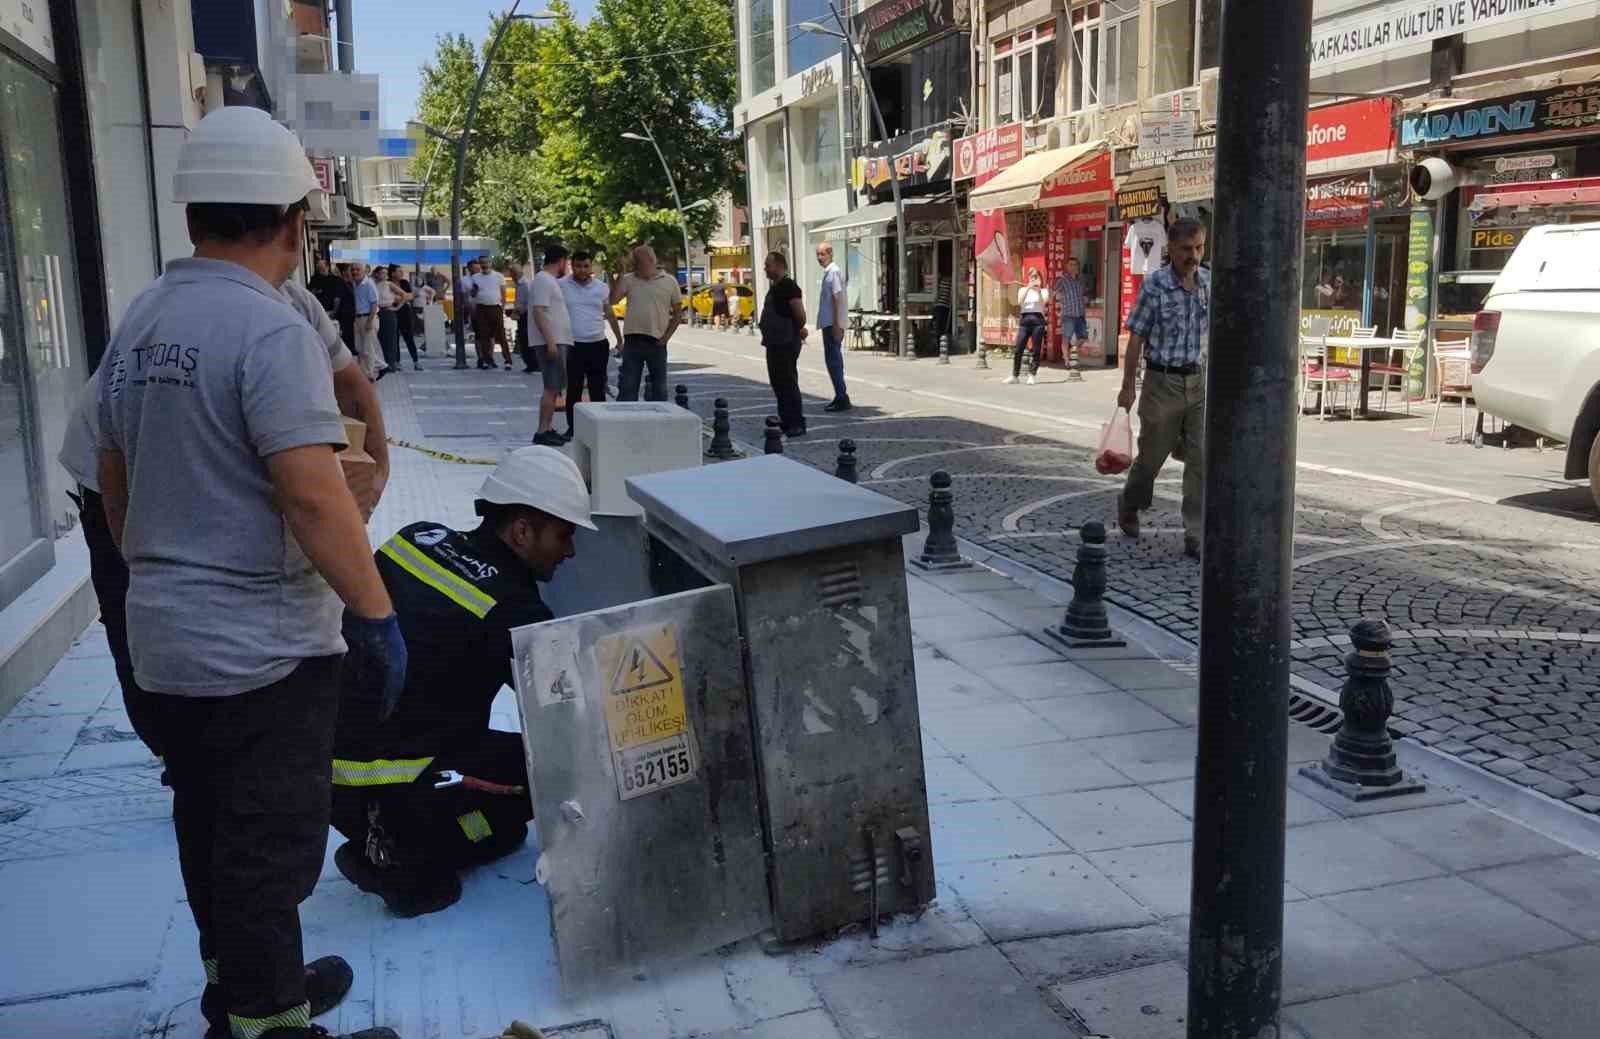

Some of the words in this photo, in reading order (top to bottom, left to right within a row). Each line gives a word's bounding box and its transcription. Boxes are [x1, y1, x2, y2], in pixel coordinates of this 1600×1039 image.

[1395, 4, 1444, 39] KÜLTÜR
[1449, 2, 1465, 26] VE
[1475, 231, 1514, 247] Pide
[624, 752, 689, 791] 652155
